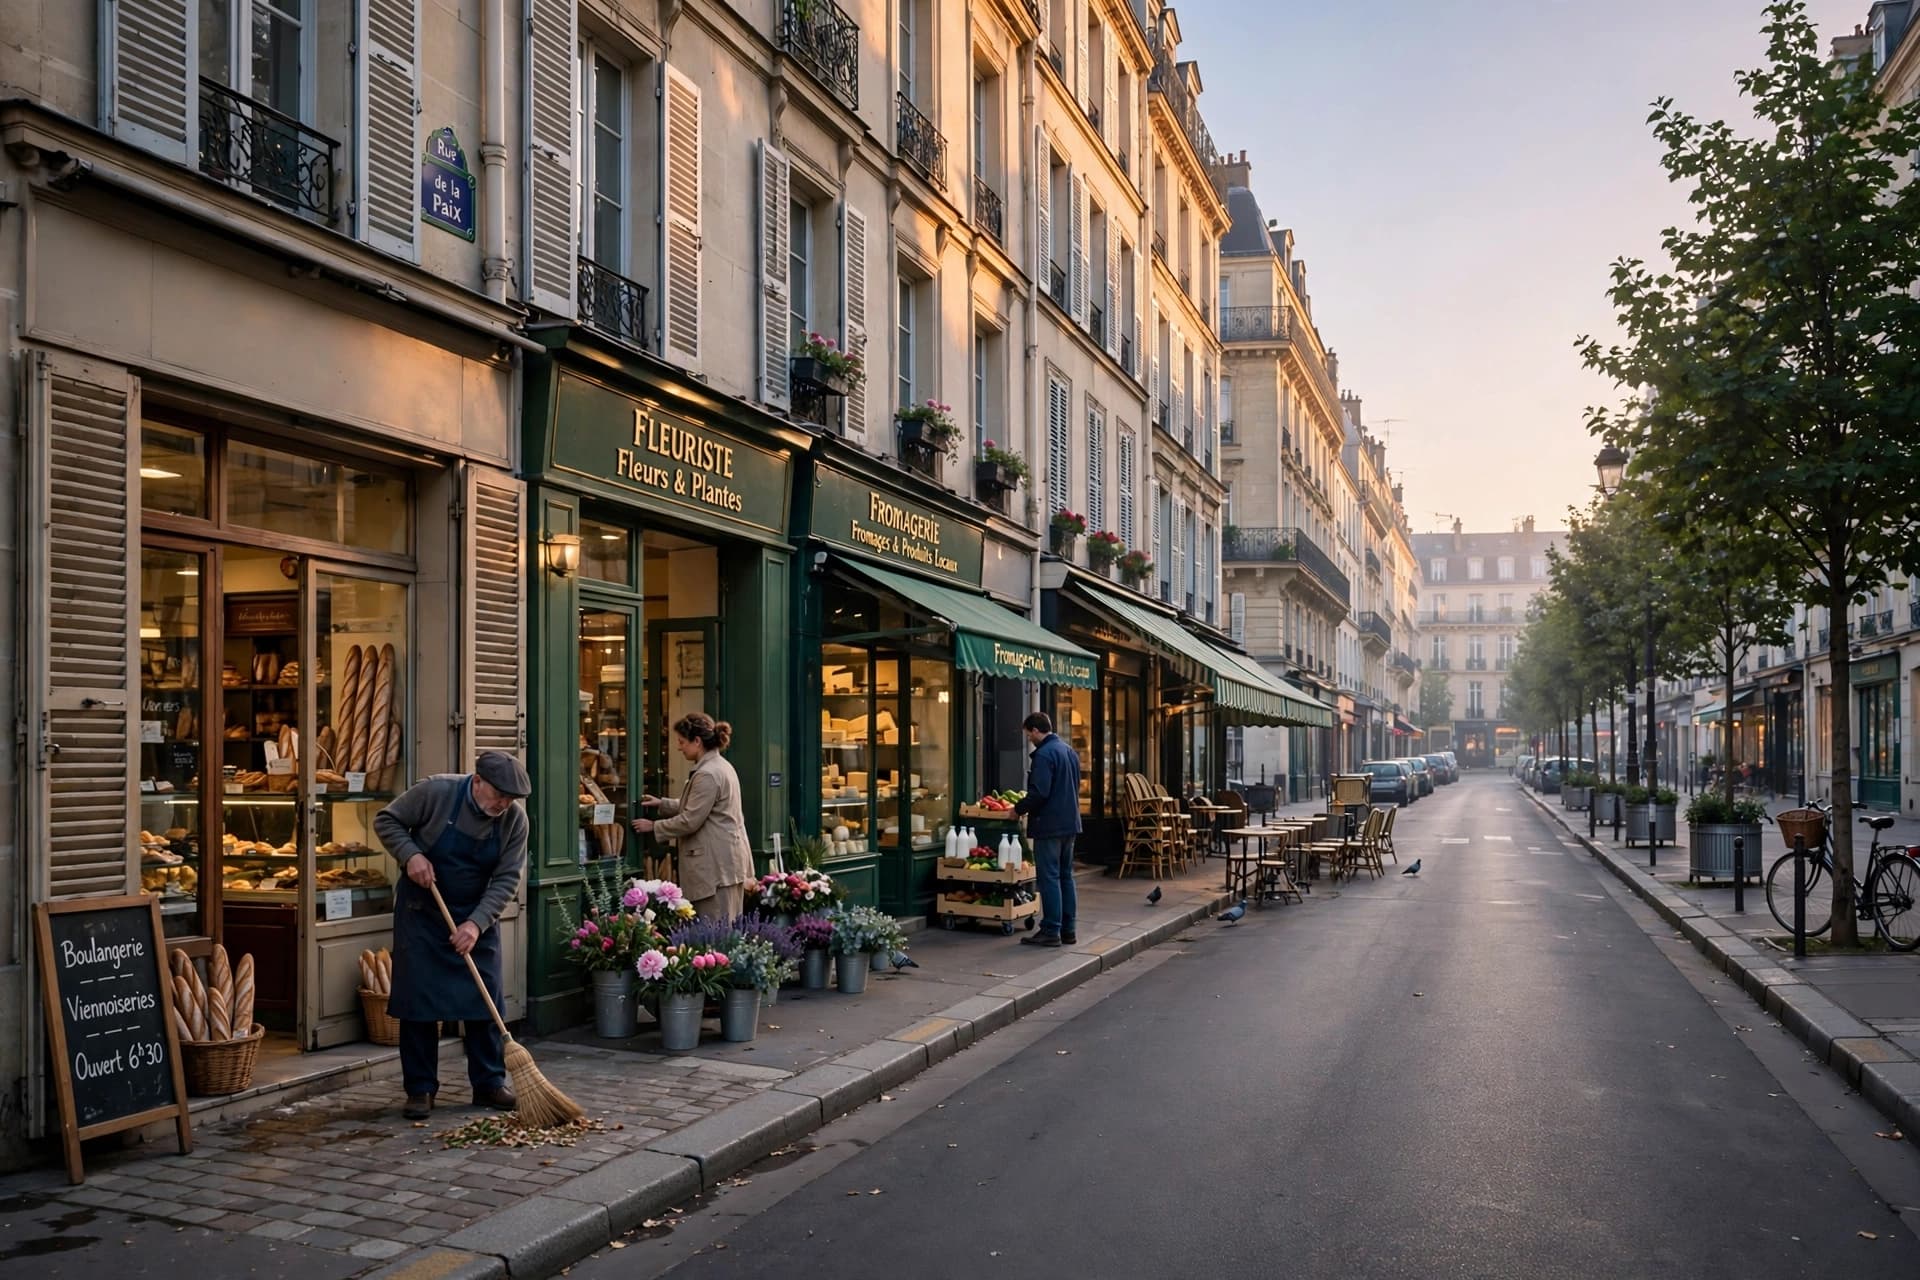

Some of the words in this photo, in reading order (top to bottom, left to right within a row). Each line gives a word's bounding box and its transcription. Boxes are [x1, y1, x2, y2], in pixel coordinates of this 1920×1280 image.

[437, 138, 457, 161] Rue
[434, 175, 447, 193] de
[451, 179, 460, 199] la
[432, 193, 462, 223] Paix
[633, 408, 734, 479] FLEURISTE
[617, 447, 669, 489] Fleurs
[673, 468, 686, 495] &
[691, 471, 742, 513] Plantes
[60, 936, 145, 969] Boulangerie
[67, 991, 156, 1022] Viennoiseries
[75, 1049, 124, 1081] Ouvert
